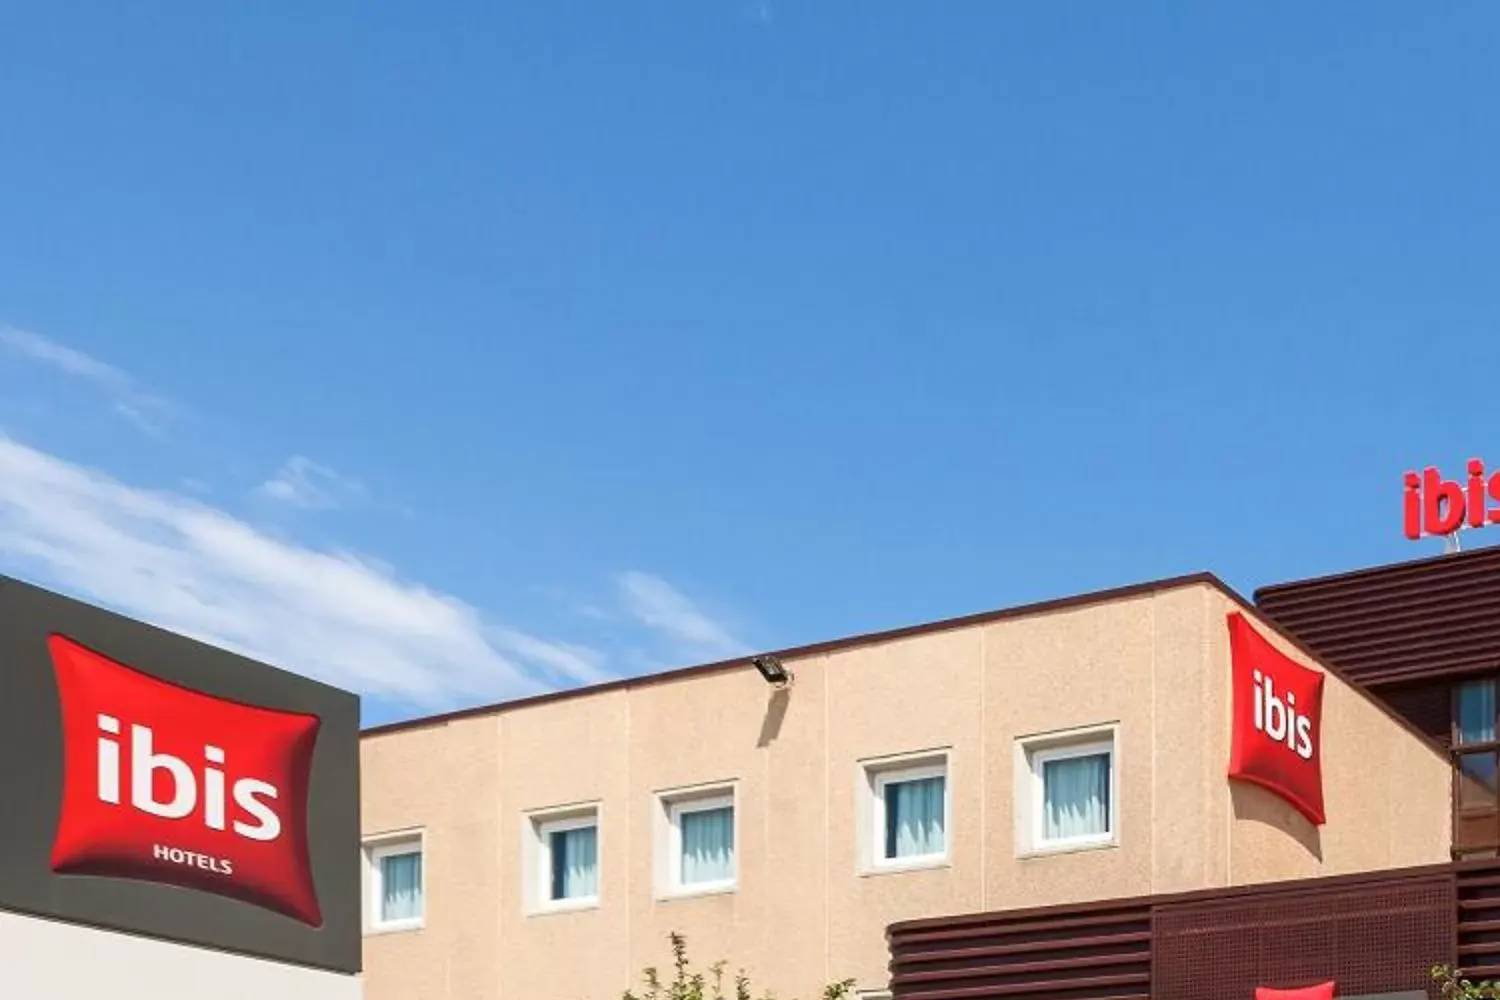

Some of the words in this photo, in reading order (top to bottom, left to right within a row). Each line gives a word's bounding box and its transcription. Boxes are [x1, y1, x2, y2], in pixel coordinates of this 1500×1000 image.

[1253, 668, 1313, 760] ibis
[97, 713, 282, 841] ibis
[153, 844, 233, 875] HOTELS
